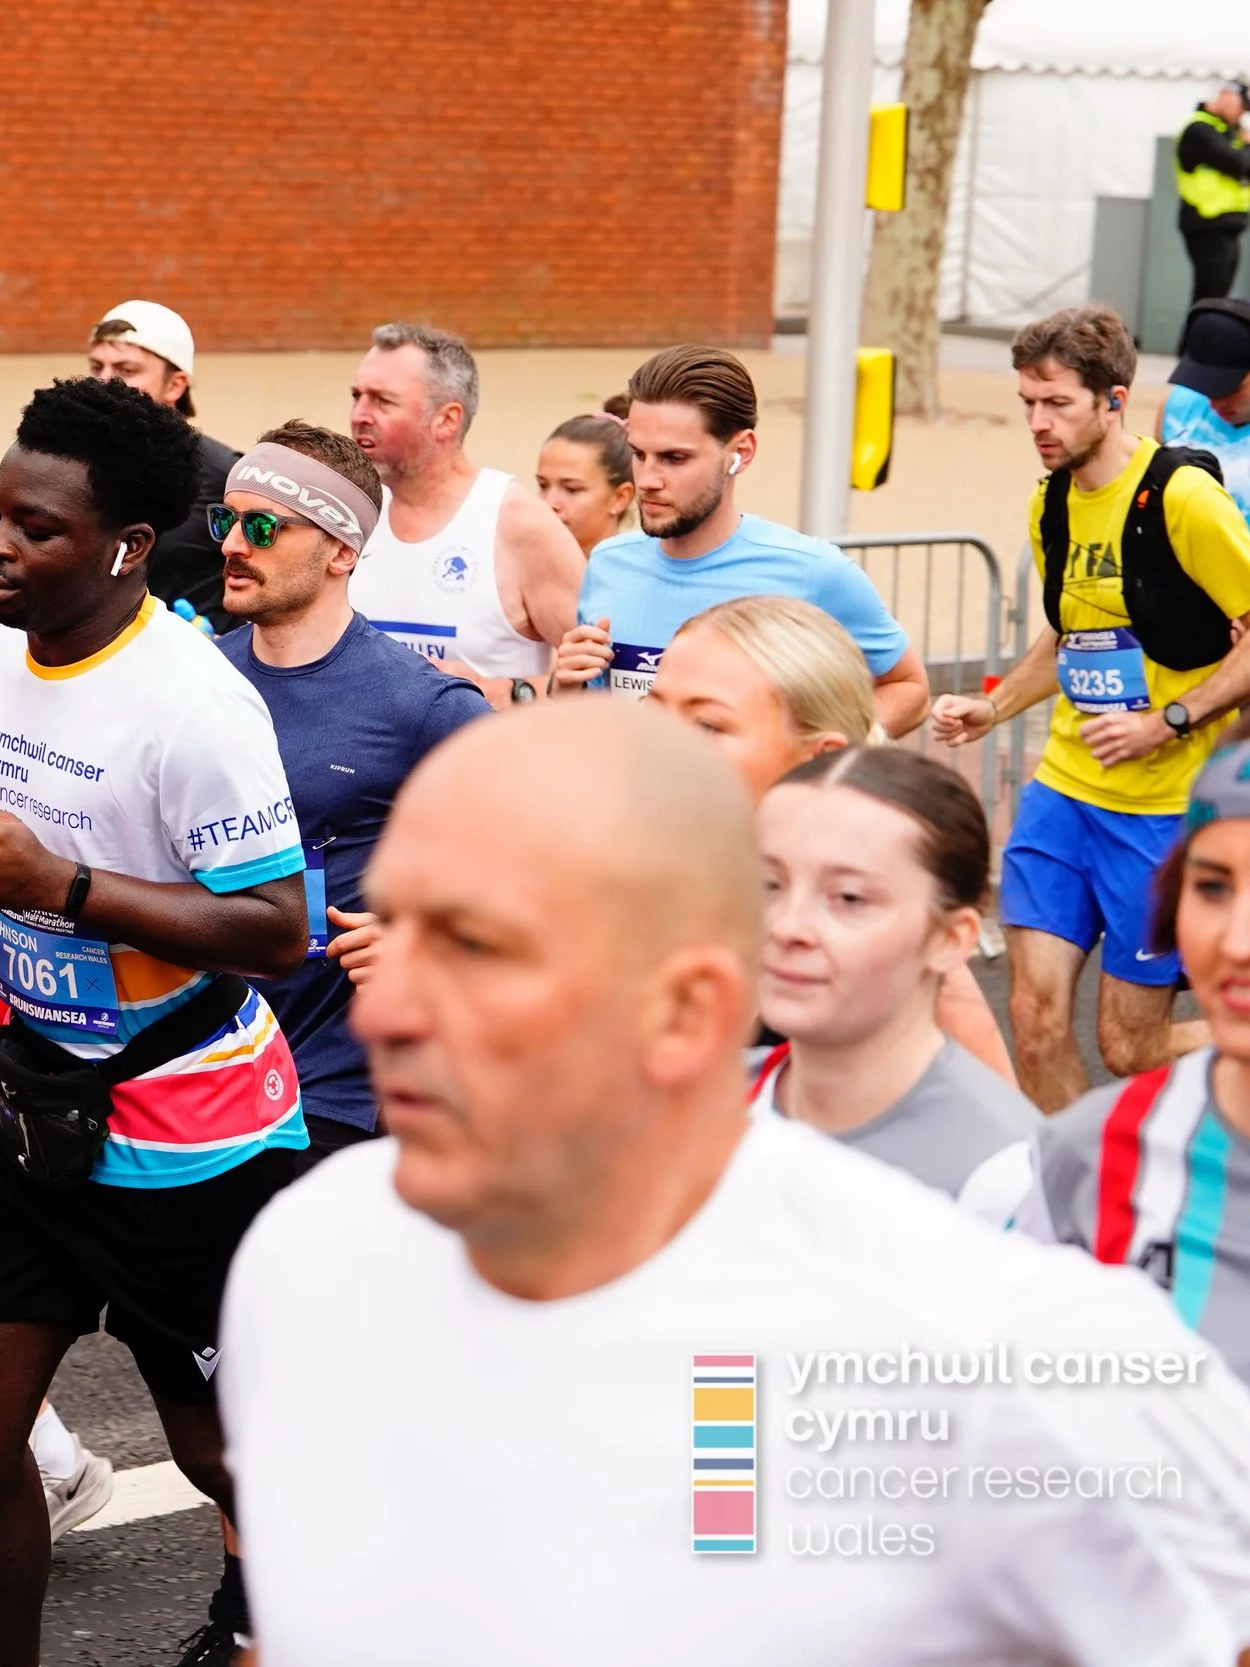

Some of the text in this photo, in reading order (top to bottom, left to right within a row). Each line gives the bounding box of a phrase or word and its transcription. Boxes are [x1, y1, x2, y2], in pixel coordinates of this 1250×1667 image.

[1068, 668, 1124, 696] 3235
[47, 750, 105, 782] canser
[330, 764, 356, 774] KIPRUN
[29, 798, 92, 831] research
[39, 914, 75, 929] Marathon
[55, 951, 108, 965] RESEARCH WALES
[81, 946, 106, 956] CANCER
[2, 943, 78, 999] 7061
[9, 993, 87, 1026] #RUNSWANSEA
